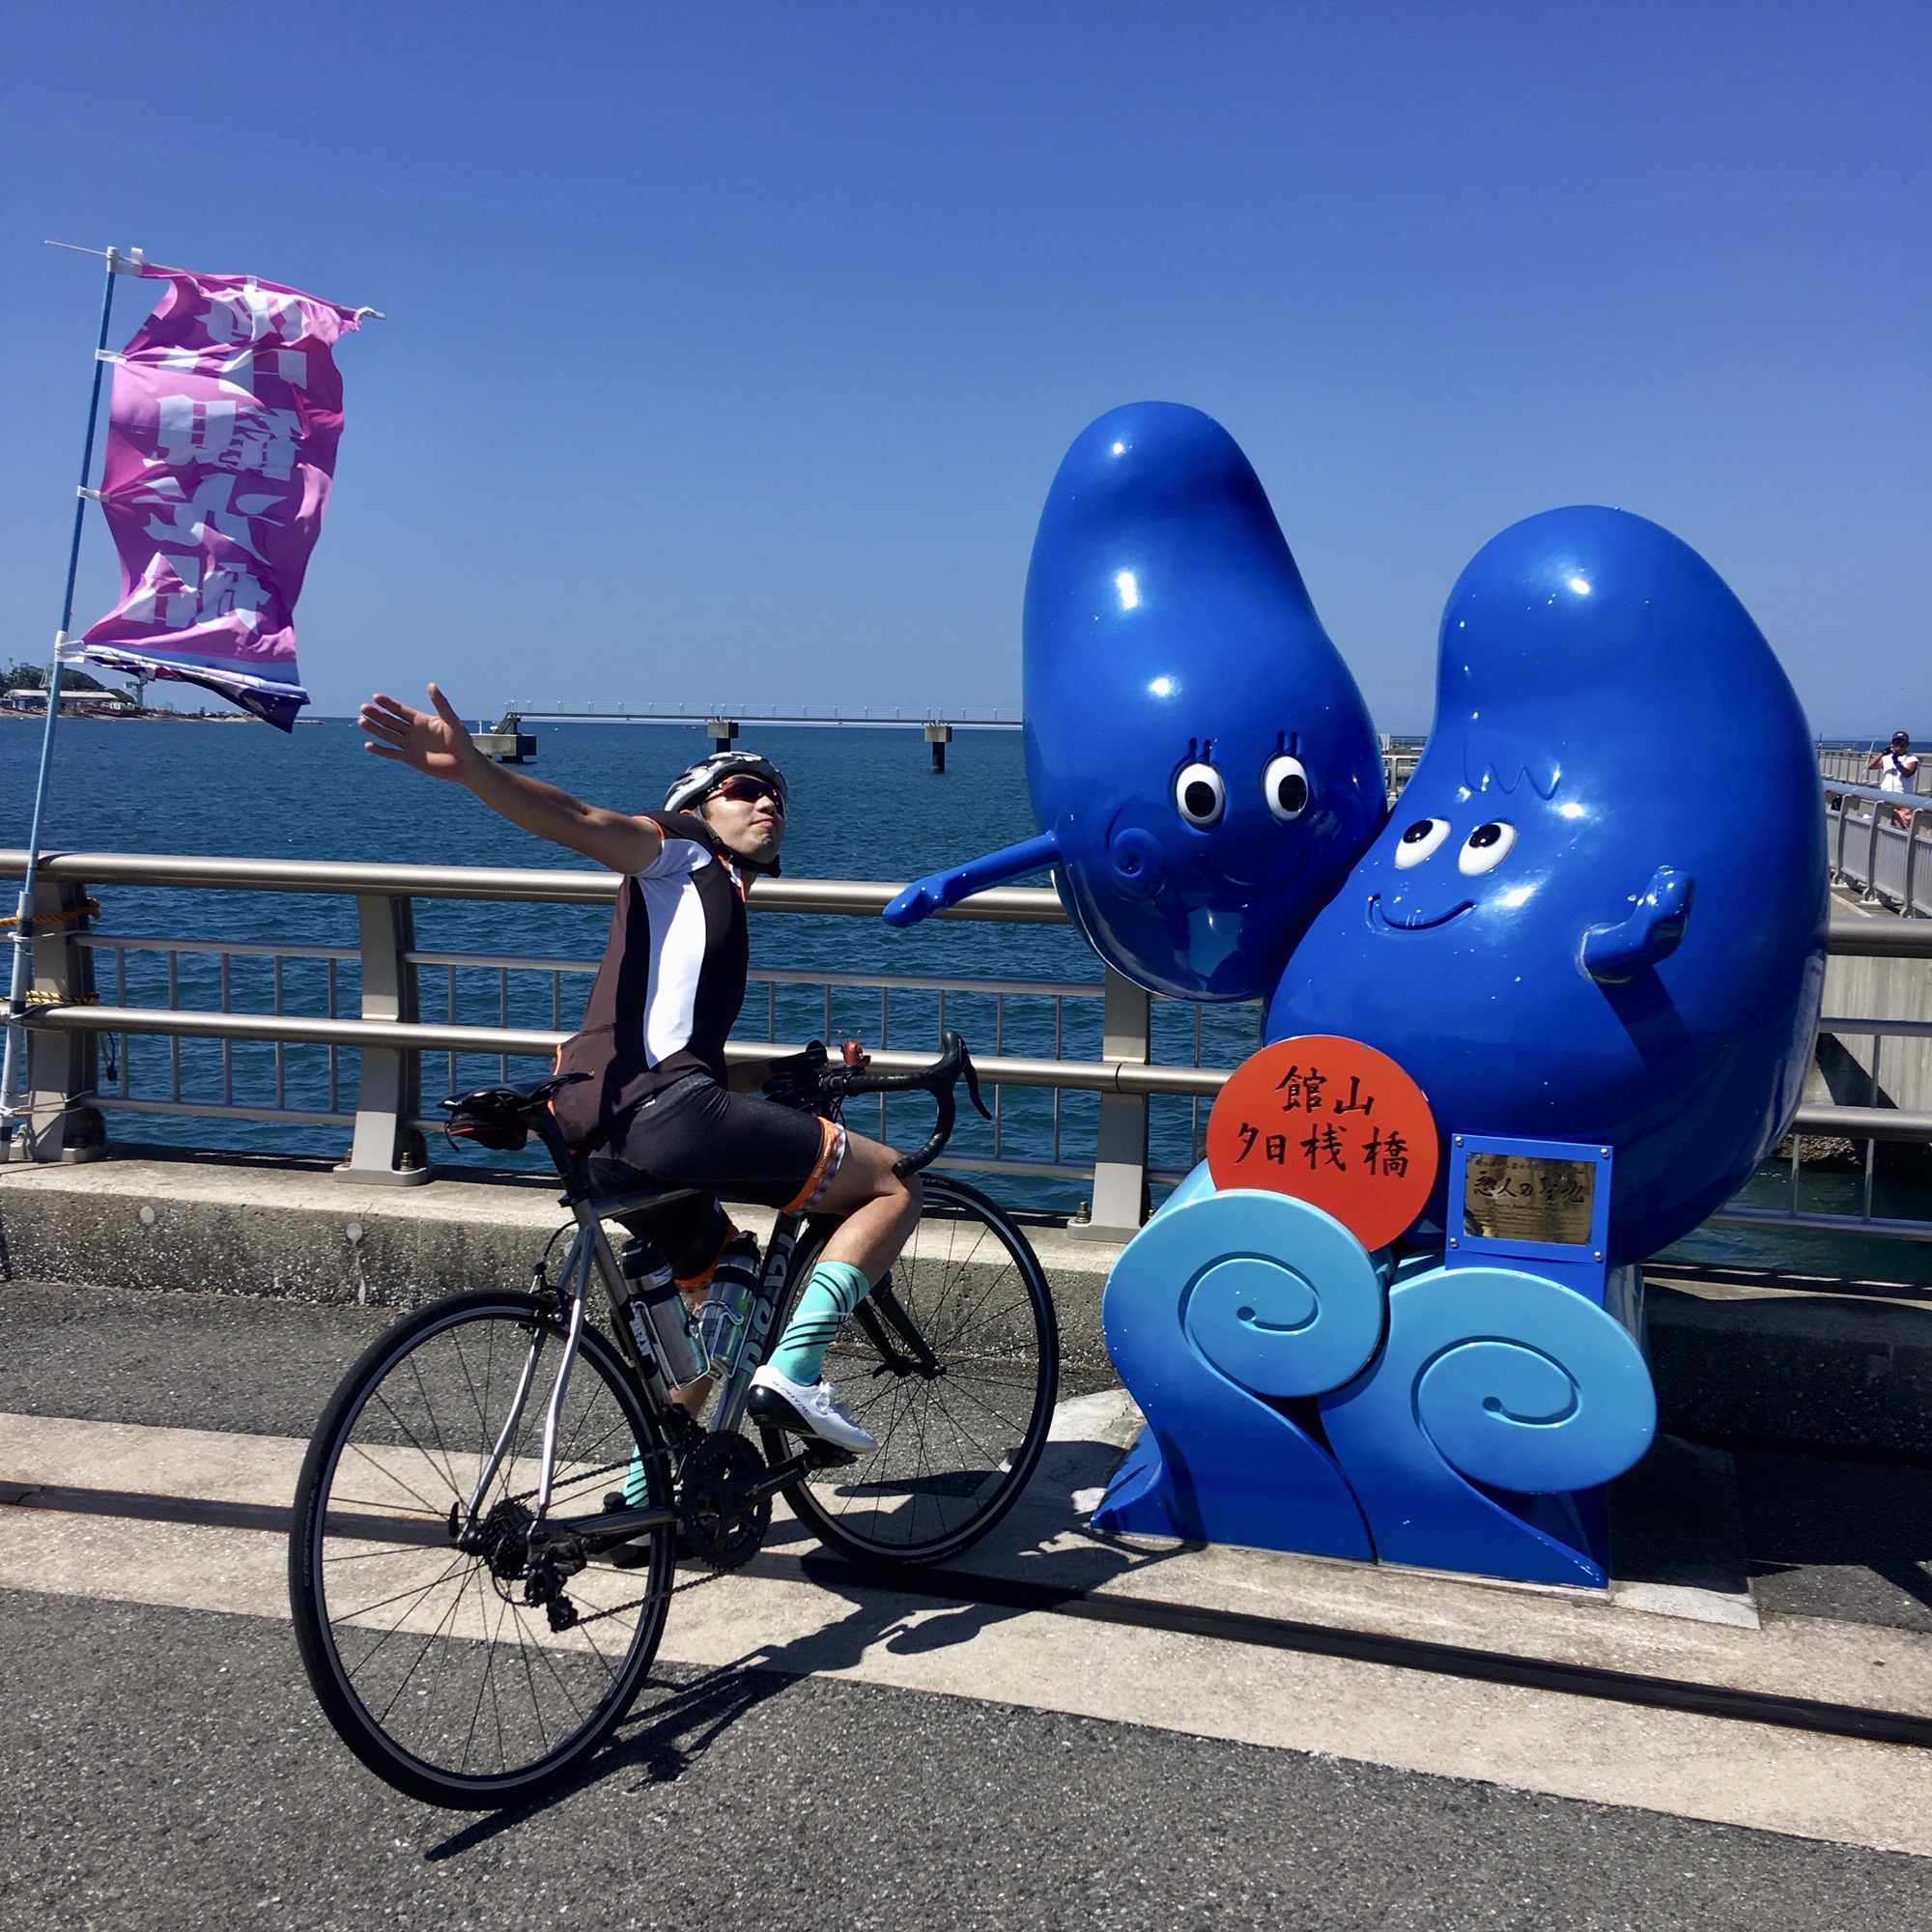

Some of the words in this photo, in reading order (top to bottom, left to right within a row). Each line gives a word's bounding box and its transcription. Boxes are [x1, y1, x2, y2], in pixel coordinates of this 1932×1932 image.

[1273, 1065, 1375, 1116] 館山
[1234, 1122, 1409, 1179] 夕日桟橋
